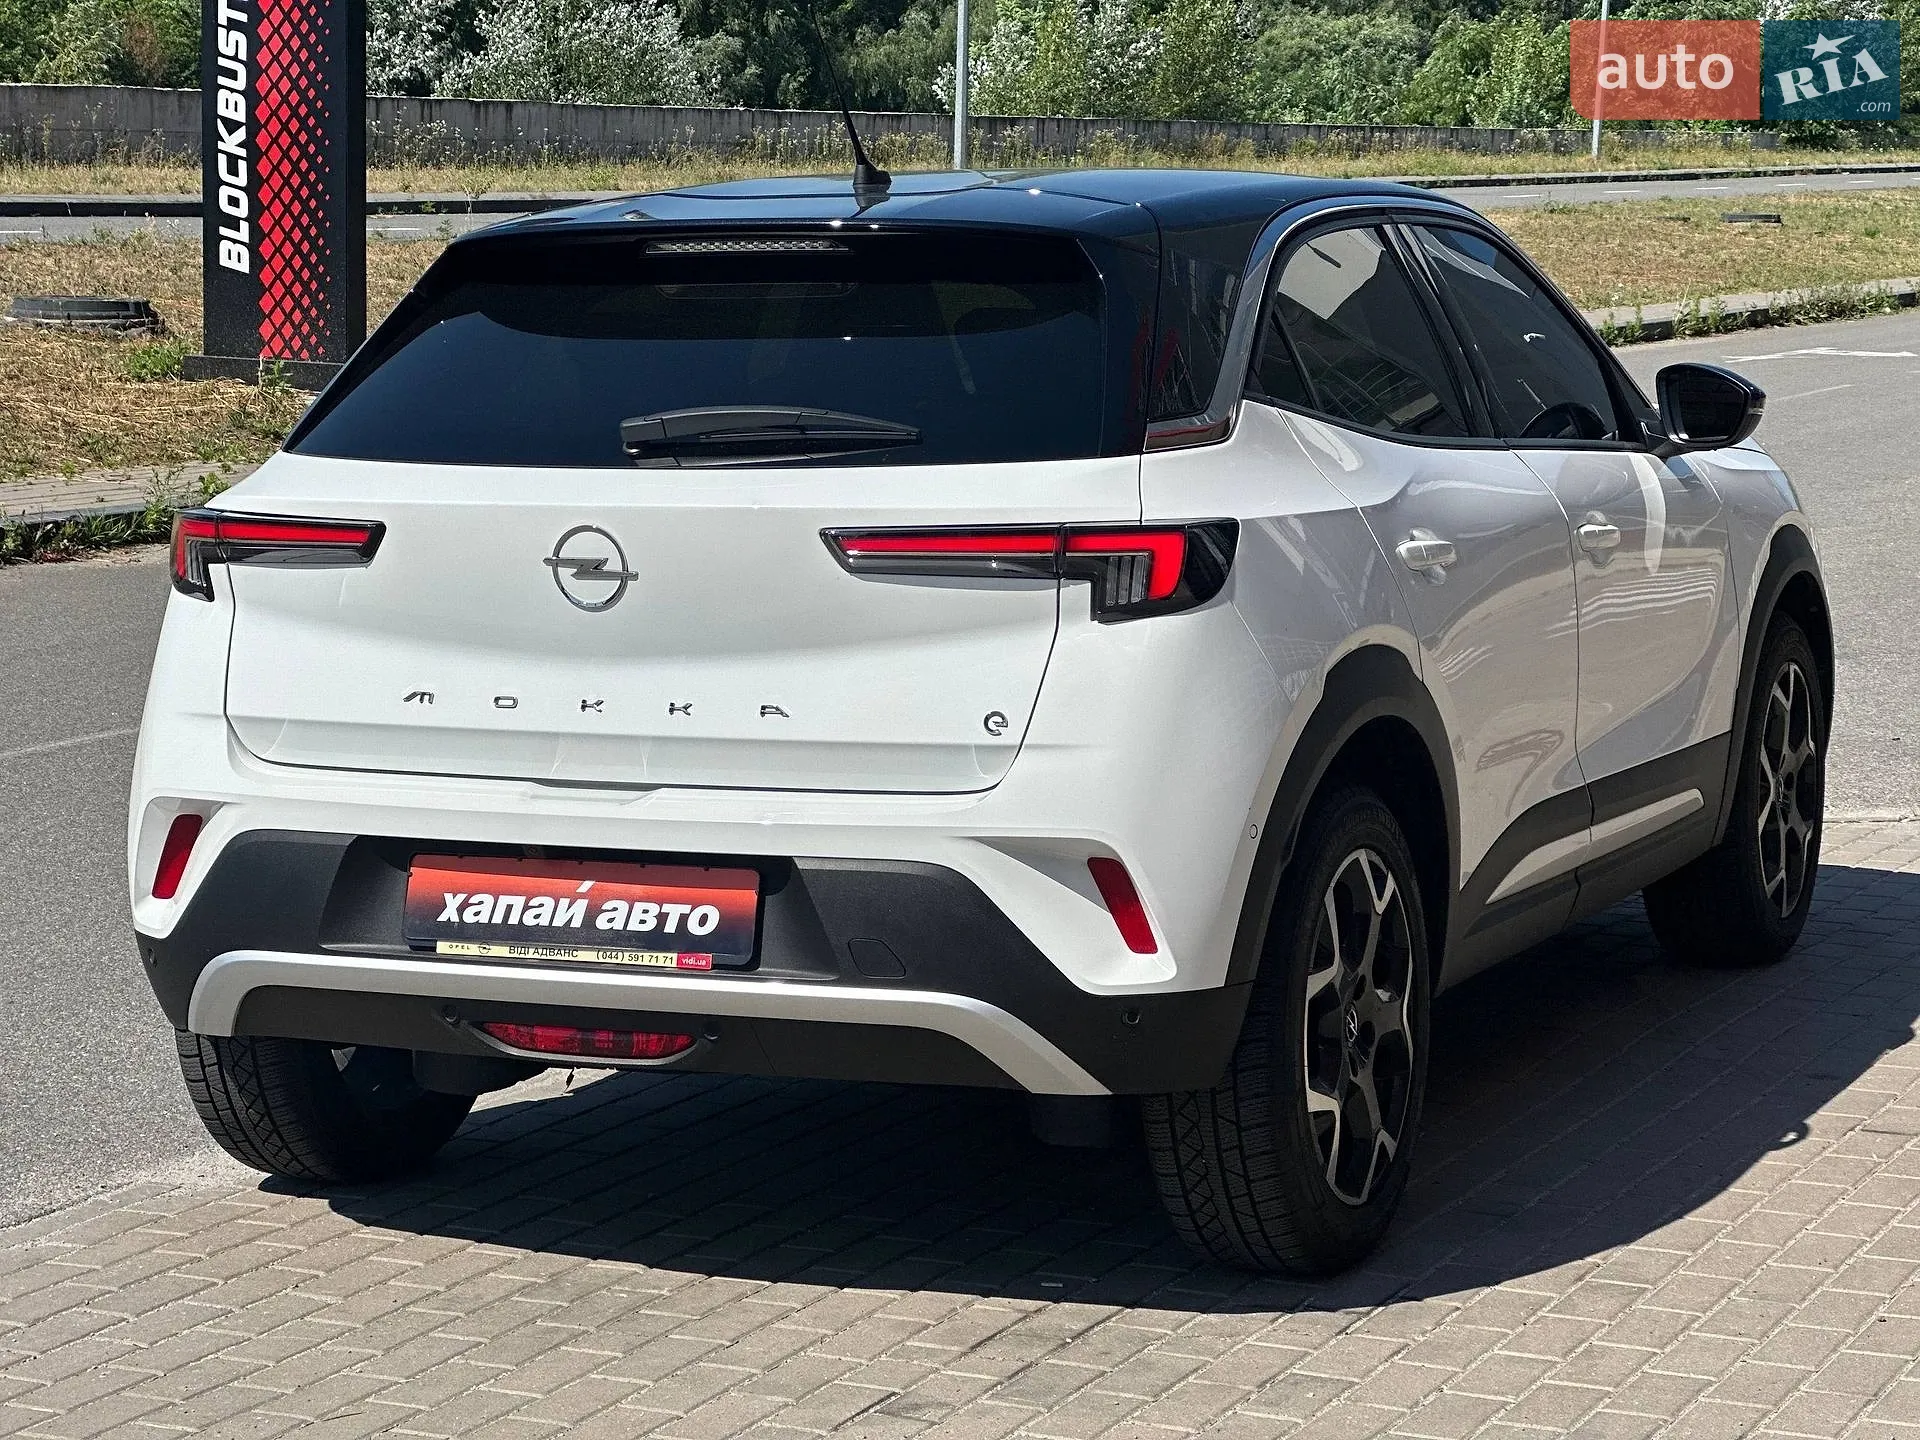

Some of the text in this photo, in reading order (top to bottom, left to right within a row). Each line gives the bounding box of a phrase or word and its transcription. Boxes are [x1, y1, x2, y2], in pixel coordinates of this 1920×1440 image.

[217, 0, 250, 274] BLOCKBUST
[403, 690, 790, 718] MOKKA
[596, 898, 720, 936] авто
[508, 945, 579, 958] ВІДІ АДВАНС
[596, 949, 674, 965] (044) 591 71 71
[681, 957, 707, 967] vidi.ua
